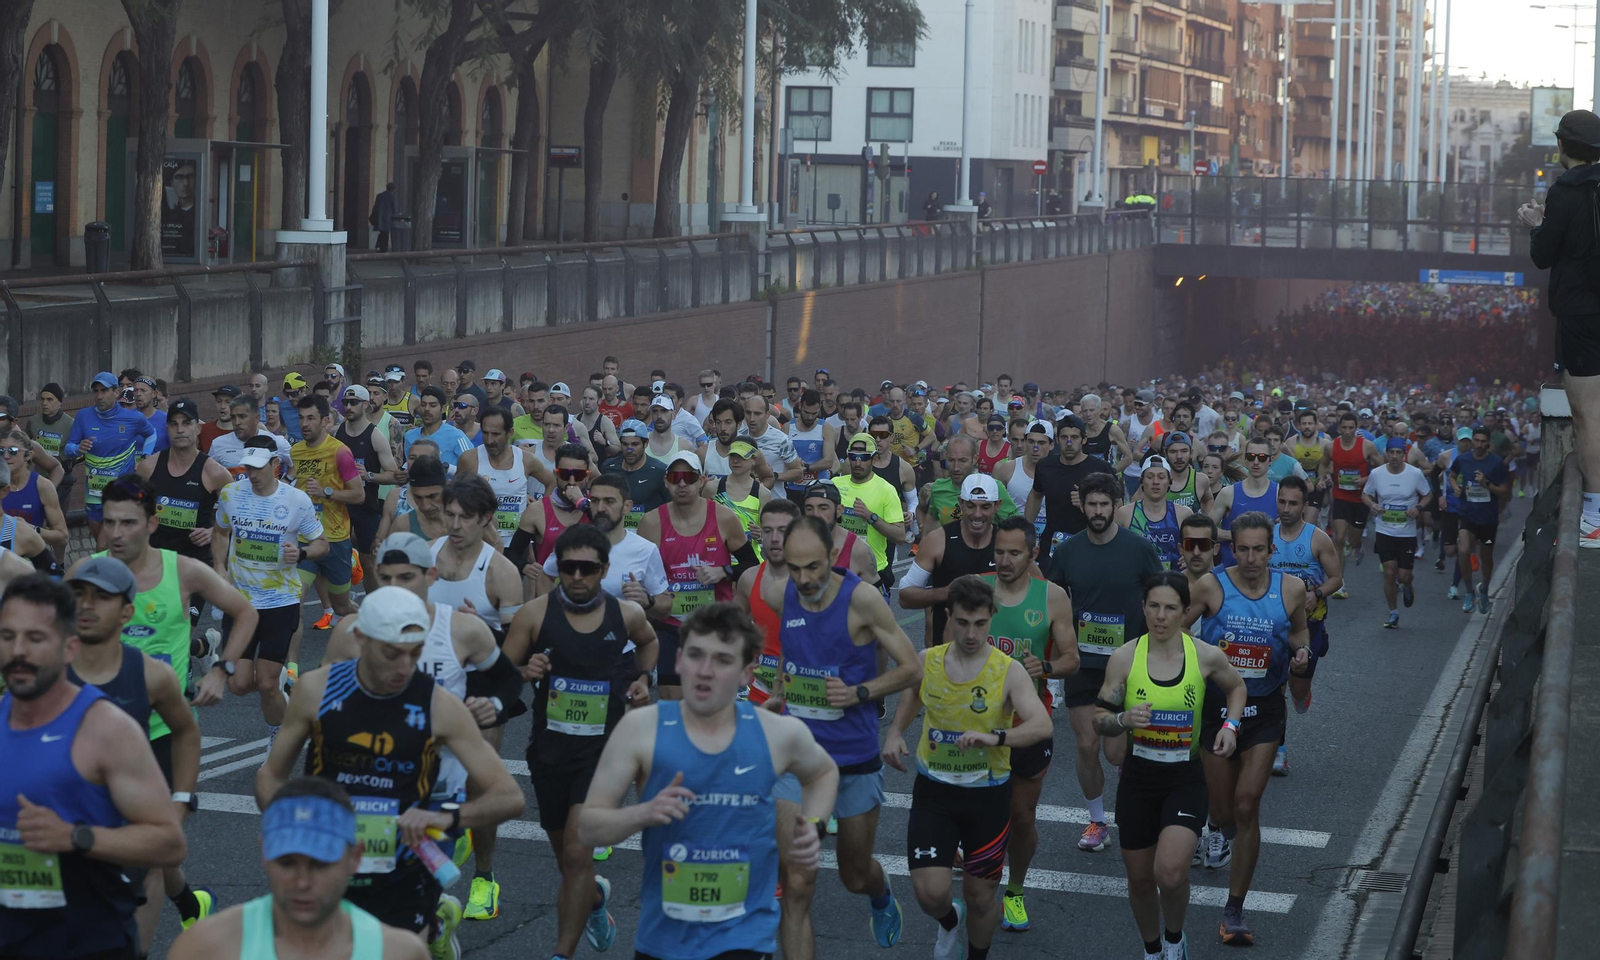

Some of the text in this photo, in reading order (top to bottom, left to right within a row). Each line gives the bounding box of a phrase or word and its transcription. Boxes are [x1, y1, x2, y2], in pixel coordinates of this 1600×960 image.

[171, 499, 195, 508] ZURICH
[232, 516, 288, 535] Falcón Training
[250, 533, 275, 542] ZURICH
[786, 618, 806, 629] HOKA
[1094, 615, 1119, 623] ZURICH
[1227, 614, 1274, 625] MEMORIAL
[128, 626, 151, 636] Ford
[1087, 633, 1114, 645] ENEKO
[1238, 635, 1268, 644] ZURICH
[1238, 648, 1251, 656] 903
[799, 667, 832, 677] ZURICH
[570, 682, 604, 692] ZURICH
[570, 699, 587, 708] 1706
[565, 709, 589, 722] ROY
[1155, 712, 1188, 721] ZURICH
[1141, 737, 1183, 749] BRENDA
[929, 761, 988, 772] PEDRO ALFONSO
[692, 848, 740, 860] ZURICH
[689, 887, 721, 903] BEN
